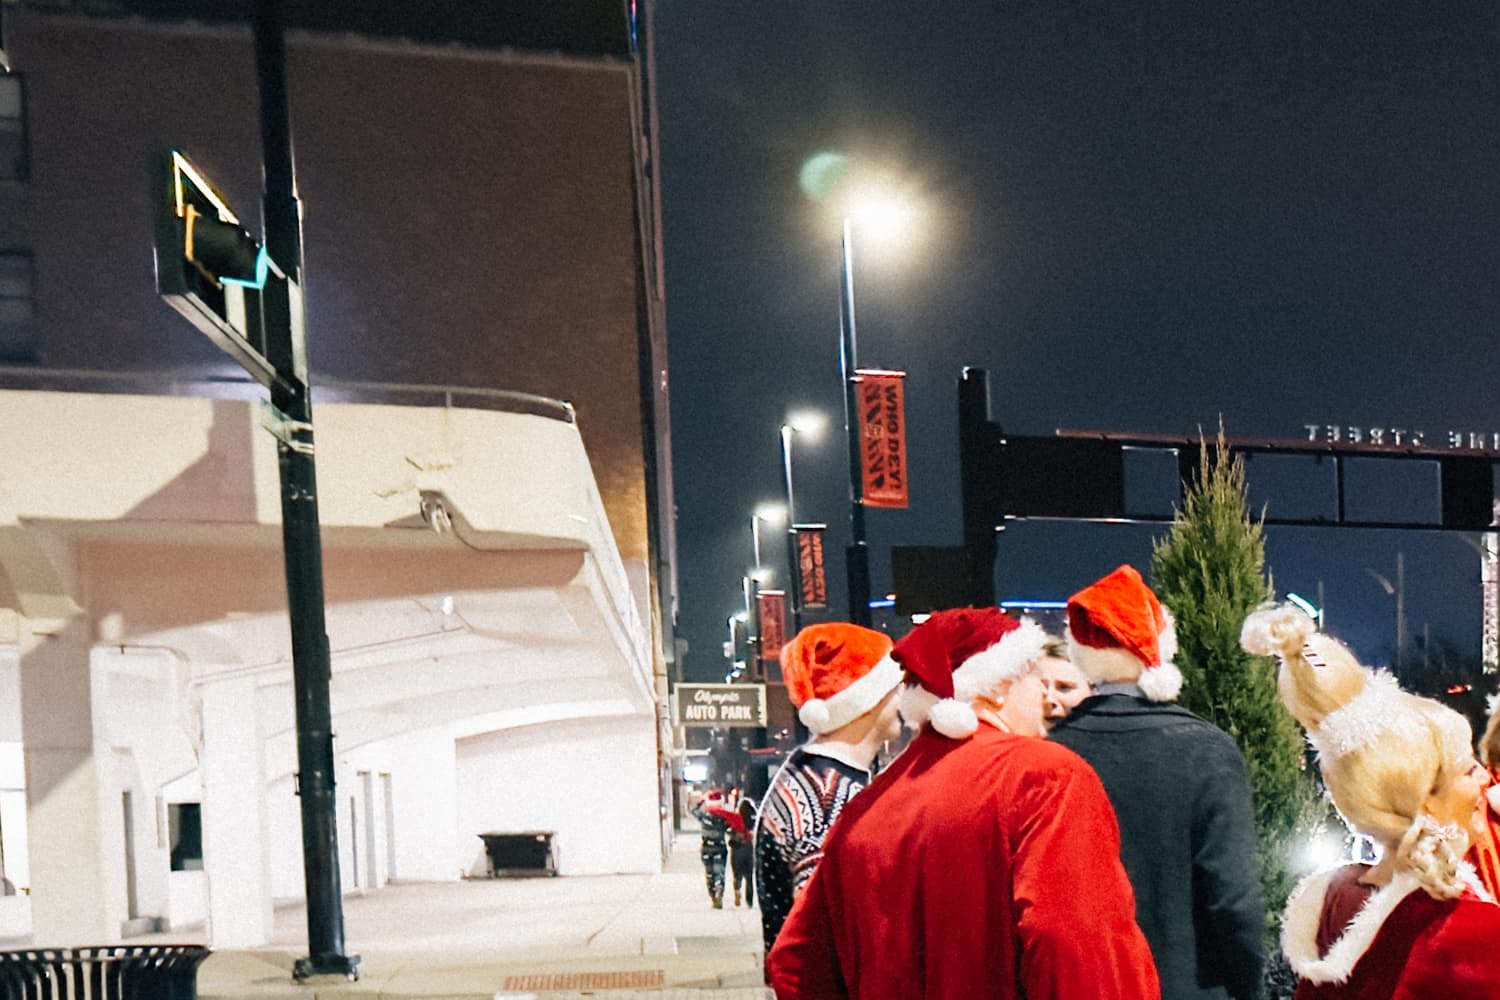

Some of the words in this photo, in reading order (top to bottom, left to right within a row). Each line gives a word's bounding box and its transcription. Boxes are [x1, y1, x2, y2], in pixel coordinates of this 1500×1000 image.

[885, 384, 899, 434] WHO
[693, 689, 740, 705] Olympic
[685, 704, 717, 720] AUTO
[720, 705, 752, 720] PARK
